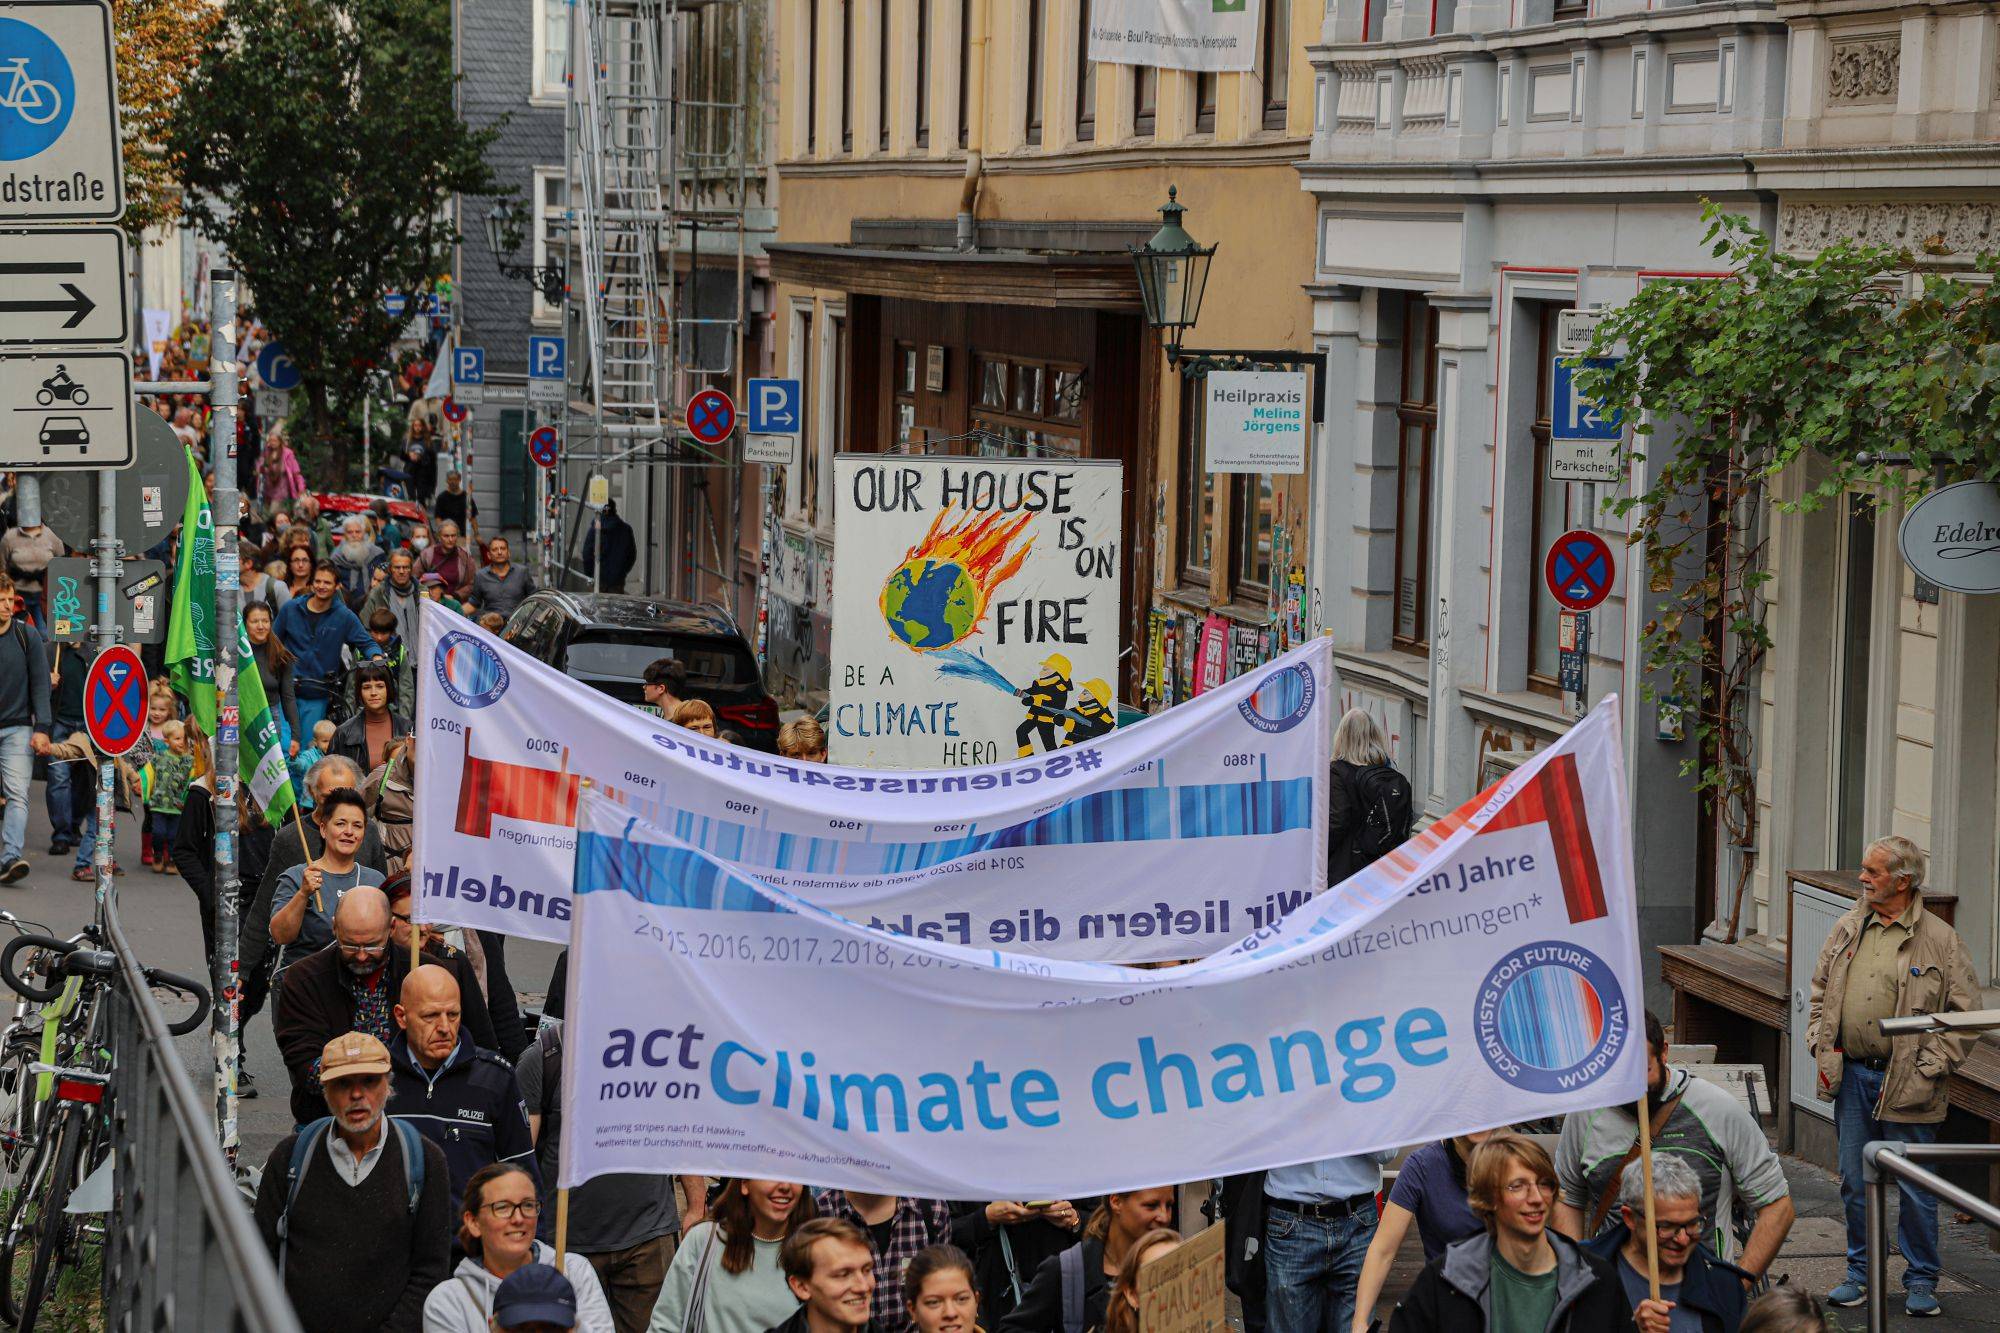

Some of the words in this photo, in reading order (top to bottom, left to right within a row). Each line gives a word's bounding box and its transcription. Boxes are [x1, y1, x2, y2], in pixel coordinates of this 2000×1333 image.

[2, 171, 104, 203] dstraße
[1213, 389, 1301, 406] Heilpraxis
[1243, 420, 1301, 435] Jörgens
[1253, 407, 1301, 419] Melina
[747, 447, 790, 458] Parkschein
[1555, 460, 1615, 473] Parkschein
[1576, 447, 1594, 458] mit
[854, 466, 927, 513] OUR
[940, 466, 1075, 515] HOUSE
[1059, 516, 1088, 551] IS
[1075, 541, 1116, 579] ON
[996, 597, 1089, 645] FIRE
[844, 664, 866, 688] BE
[879, 665, 895, 686] A
[835, 700, 961, 738] CLIMATE
[943, 740, 998, 766] HERO
[1458, 852, 1536, 893] Jahre
[699, 933, 757, 964] 2016,
[763, 938, 823, 966] 2017,
[830, 939, 894, 969] 2018,
[1523, 946, 1592, 972] FUTURE
[1492, 958, 1524, 988] FOR
[601, 1023, 705, 1070] act
[1479, 989, 1521, 1078] SCIENTISTS
[1556, 999, 1625, 1089] WUPPERTAL
[709, 1039, 1061, 1133] Climate
[1091, 1006, 1450, 1120] change
[599, 1080, 657, 1101] now
[665, 1081, 701, 1101] on
[457, 1108, 485, 1121] POLIZEI
[595, 1123, 632, 1135] Warming
[633, 1122, 665, 1133] stripes
[667, 1123, 690, 1133] nach
[692, 1124, 704, 1134] Ed
[706, 1125, 746, 1137] Hawkins
